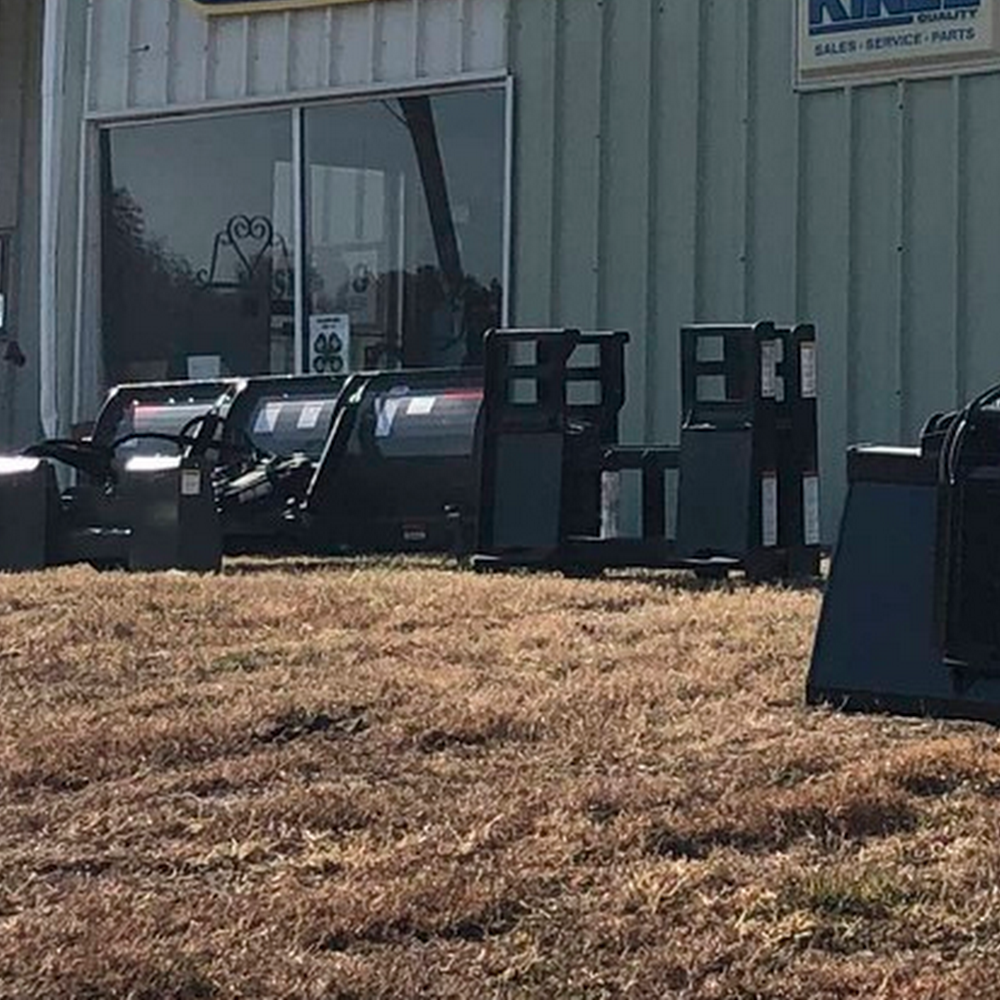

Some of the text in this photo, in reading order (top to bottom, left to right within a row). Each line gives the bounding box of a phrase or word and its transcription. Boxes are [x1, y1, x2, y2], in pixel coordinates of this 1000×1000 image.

[917, 8, 978, 24] QUALITY
[815, 27, 976, 57] SALES SERVICE PARTS
